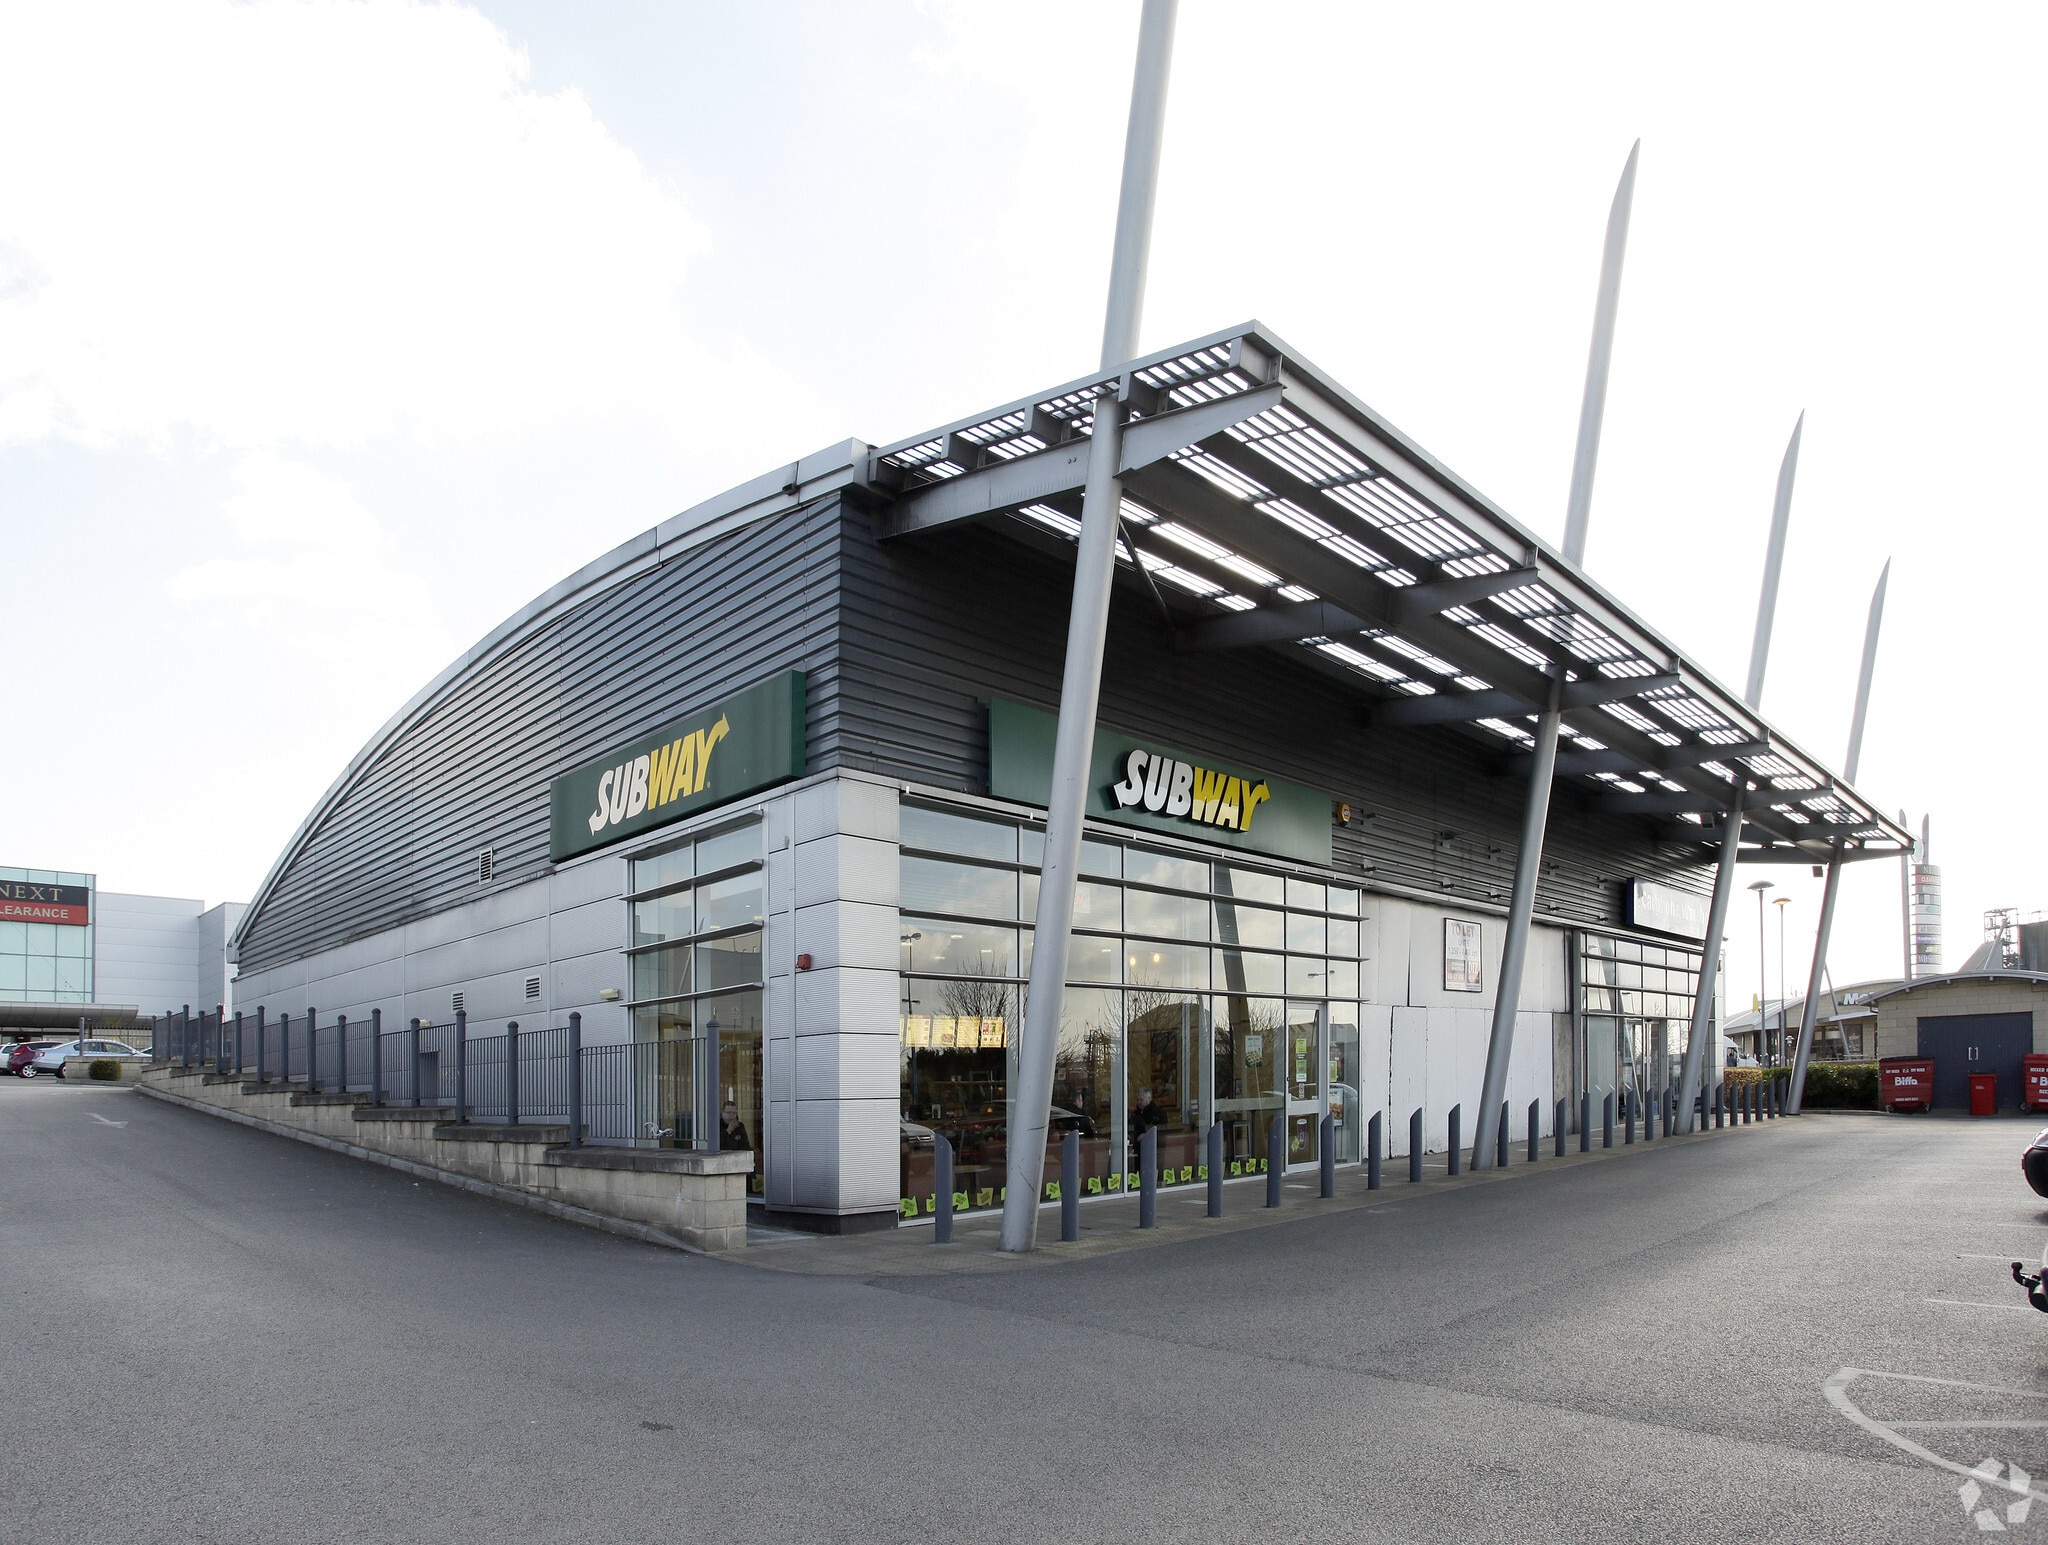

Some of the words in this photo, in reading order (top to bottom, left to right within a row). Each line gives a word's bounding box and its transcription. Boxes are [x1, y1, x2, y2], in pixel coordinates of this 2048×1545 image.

[588, 712, 730, 836] SUBWAY
[1112, 749, 1271, 832] SUBWAY
[0, 904, 69, 919] EARANCE
[1894, 1076, 1918, 1086] Biffa
